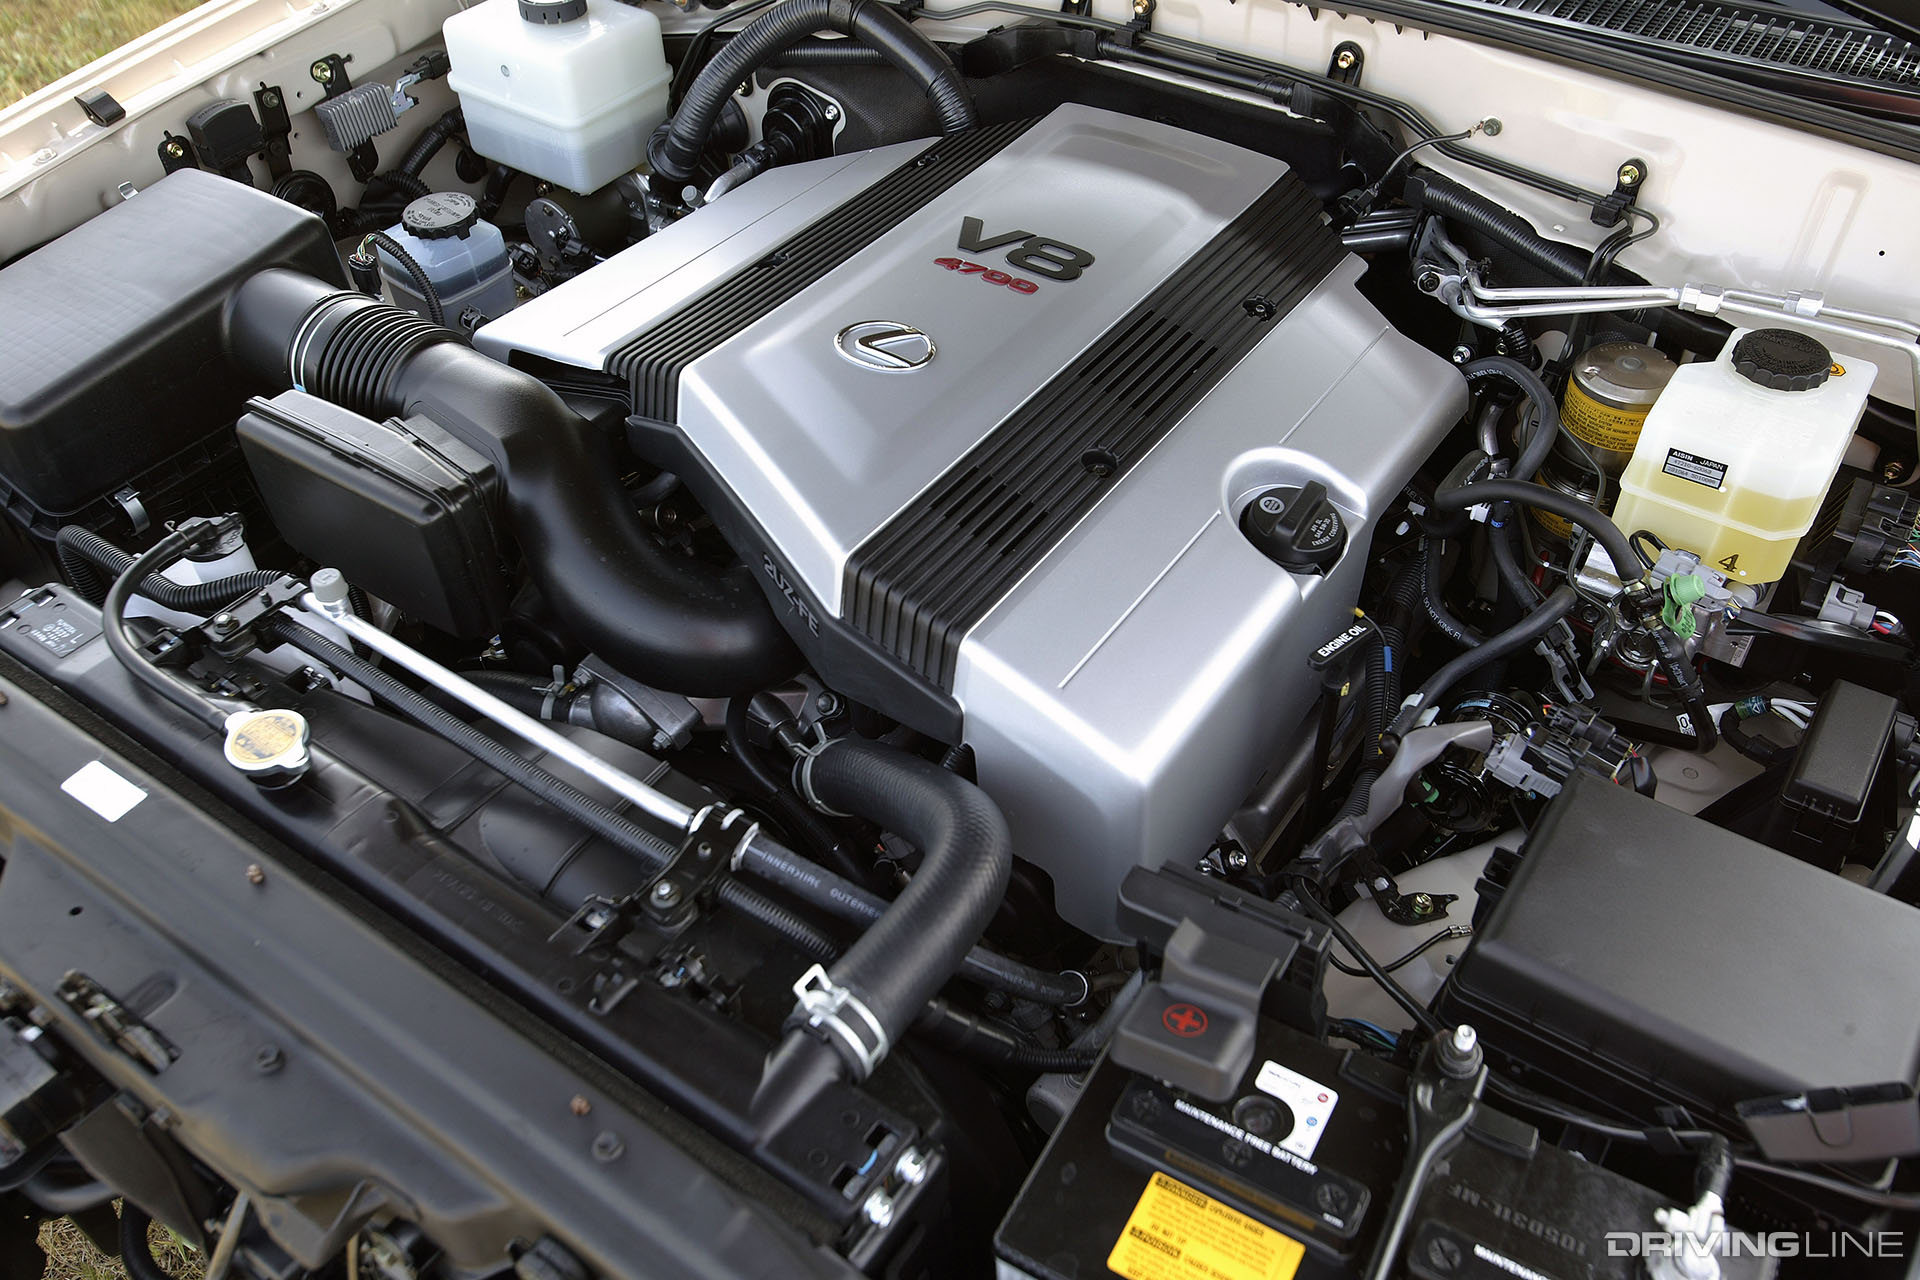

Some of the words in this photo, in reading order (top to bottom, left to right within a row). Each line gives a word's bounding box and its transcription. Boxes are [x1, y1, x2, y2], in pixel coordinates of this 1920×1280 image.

[957, 215, 1096, 282] V8
[934, 257, 1040, 295] 4700
[1672, 451, 1694, 461] AISIN
[1699, 459, 1724, 471] JAPAN
[1718, 554, 1739, 573] 4
[763, 553, 820, 638] 2UZ-FE
[1317, 632, 1353, 657] ENGINE
[1348, 624, 1368, 636] OIL
[1173, 1098, 1246, 1142] MAINTENANCE
[1243, 1132, 1273, 1155] FREE
[1270, 1145, 1319, 1176] BATTERY
